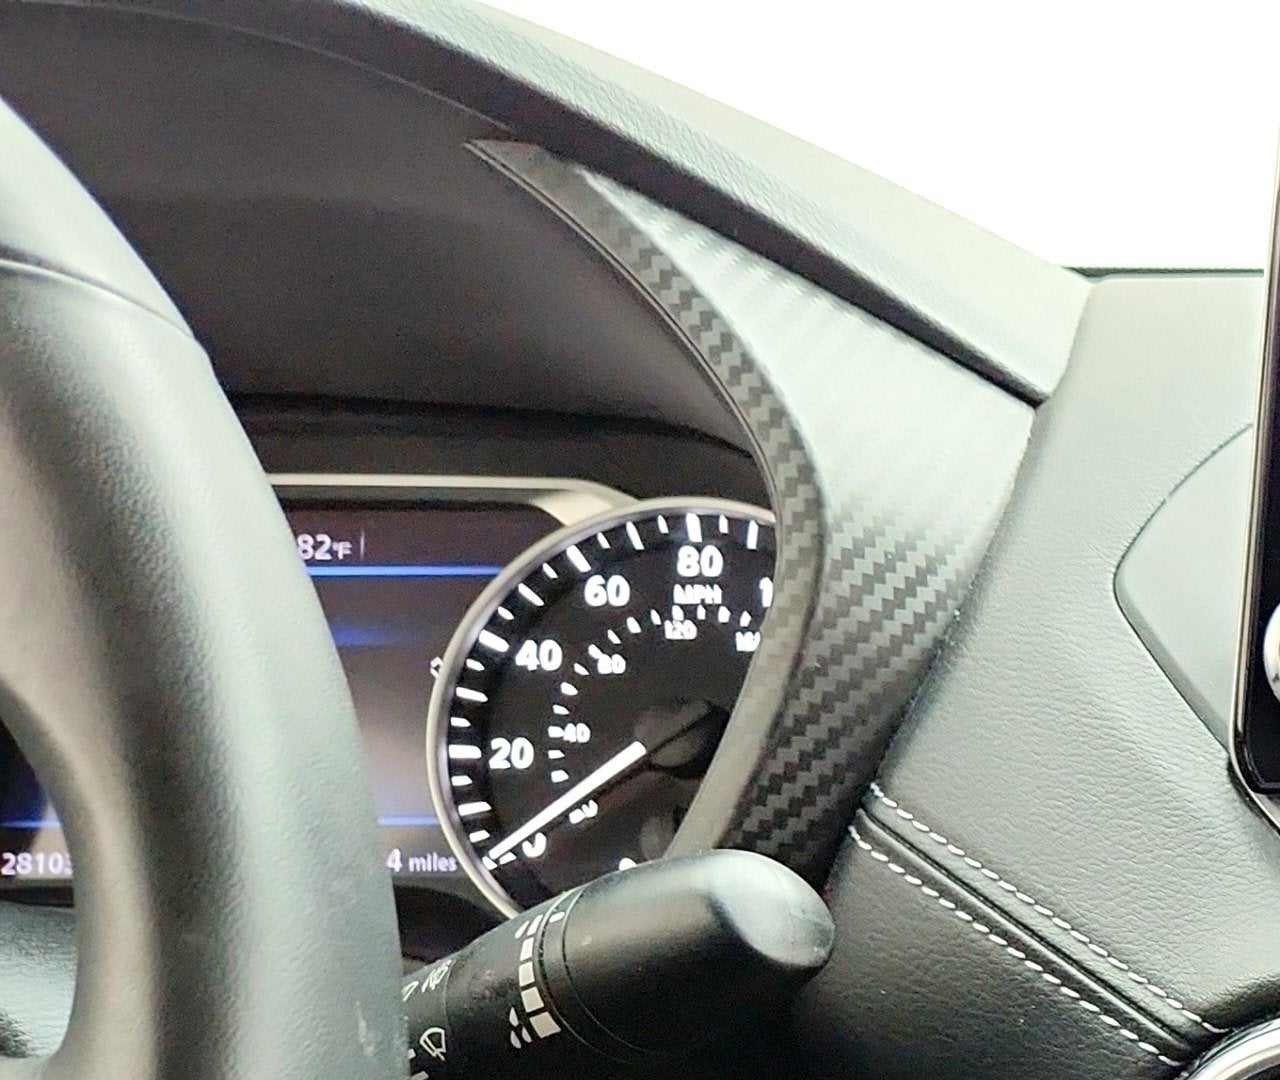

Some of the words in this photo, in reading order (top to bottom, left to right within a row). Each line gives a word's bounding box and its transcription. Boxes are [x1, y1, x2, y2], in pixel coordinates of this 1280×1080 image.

[676, 545, 723, 577] 80
[584, 575, 630, 606] 60
[673, 584, 722, 604] MPH
[515, 639, 563, 671] 40
[488, 737, 535, 769] 20
[409, 852, 457, 872] miles
